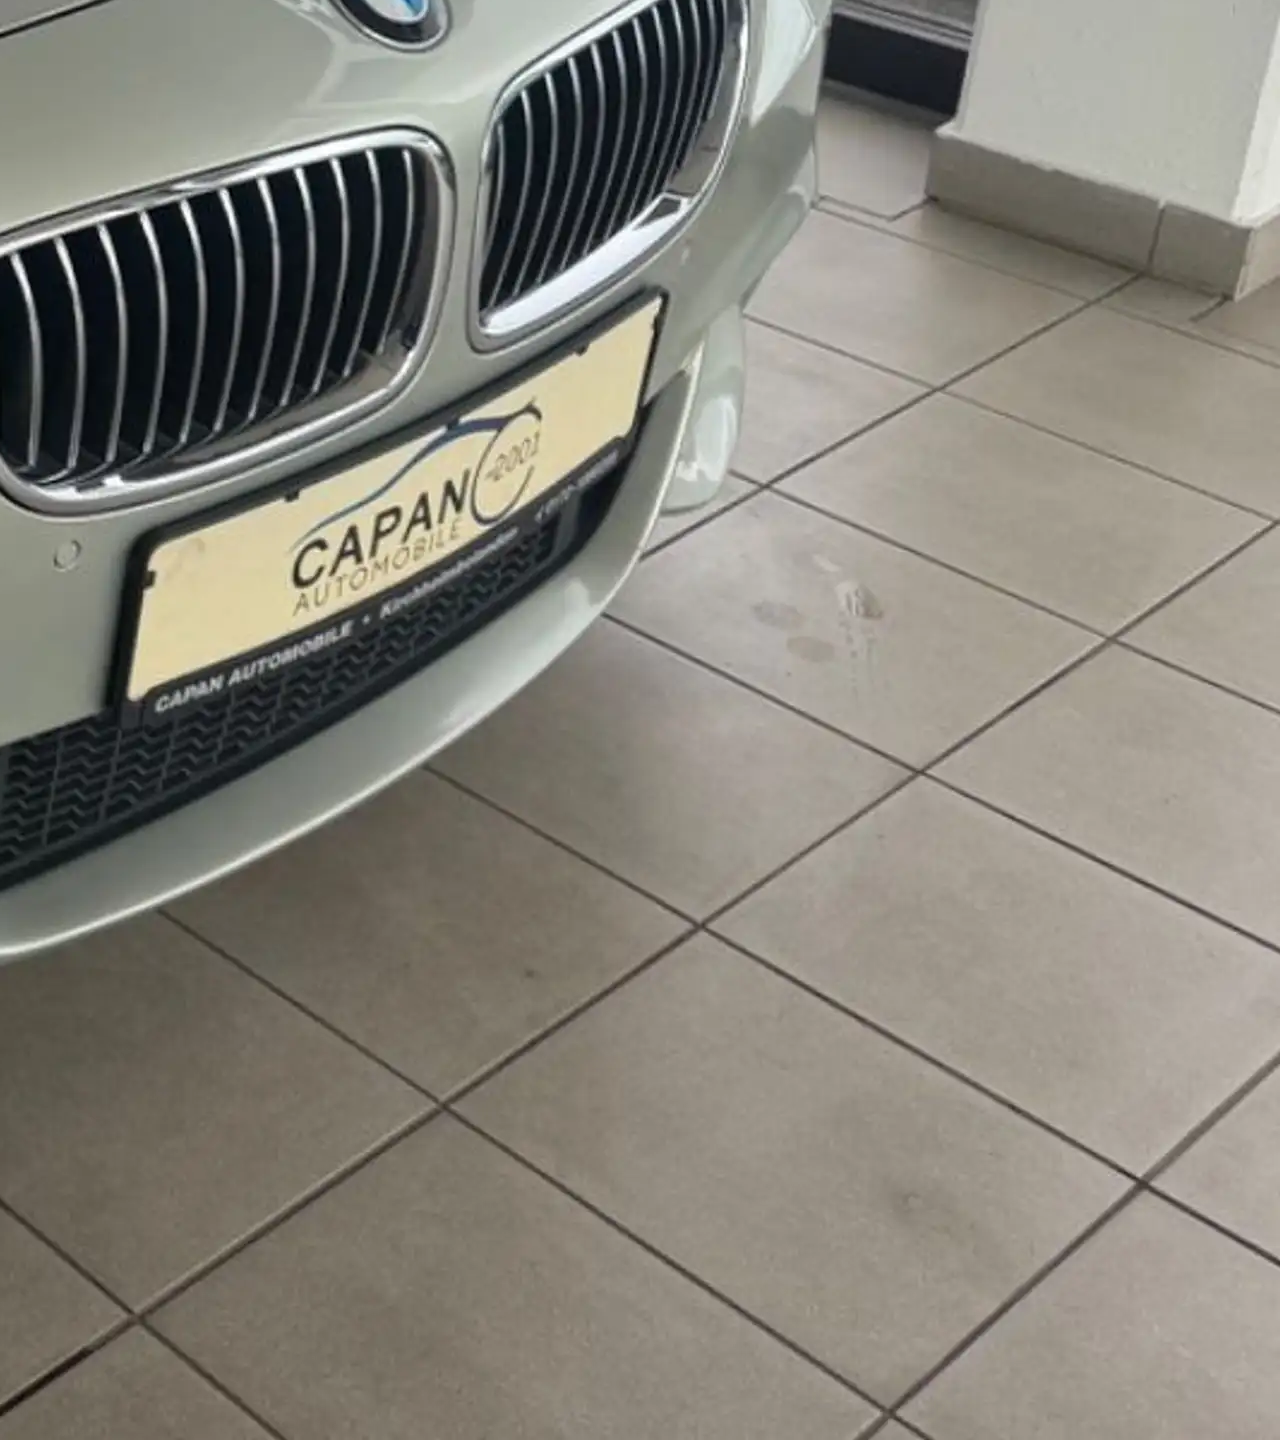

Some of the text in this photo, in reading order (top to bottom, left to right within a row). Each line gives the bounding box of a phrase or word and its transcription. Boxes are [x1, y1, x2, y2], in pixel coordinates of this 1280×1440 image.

[292, 468, 471, 589] CAPAN
[292, 517, 464, 617] AUTOMOBILE
[154, 674, 224, 712] CAPAN
[227, 619, 354, 687] AUTOMOBILE
